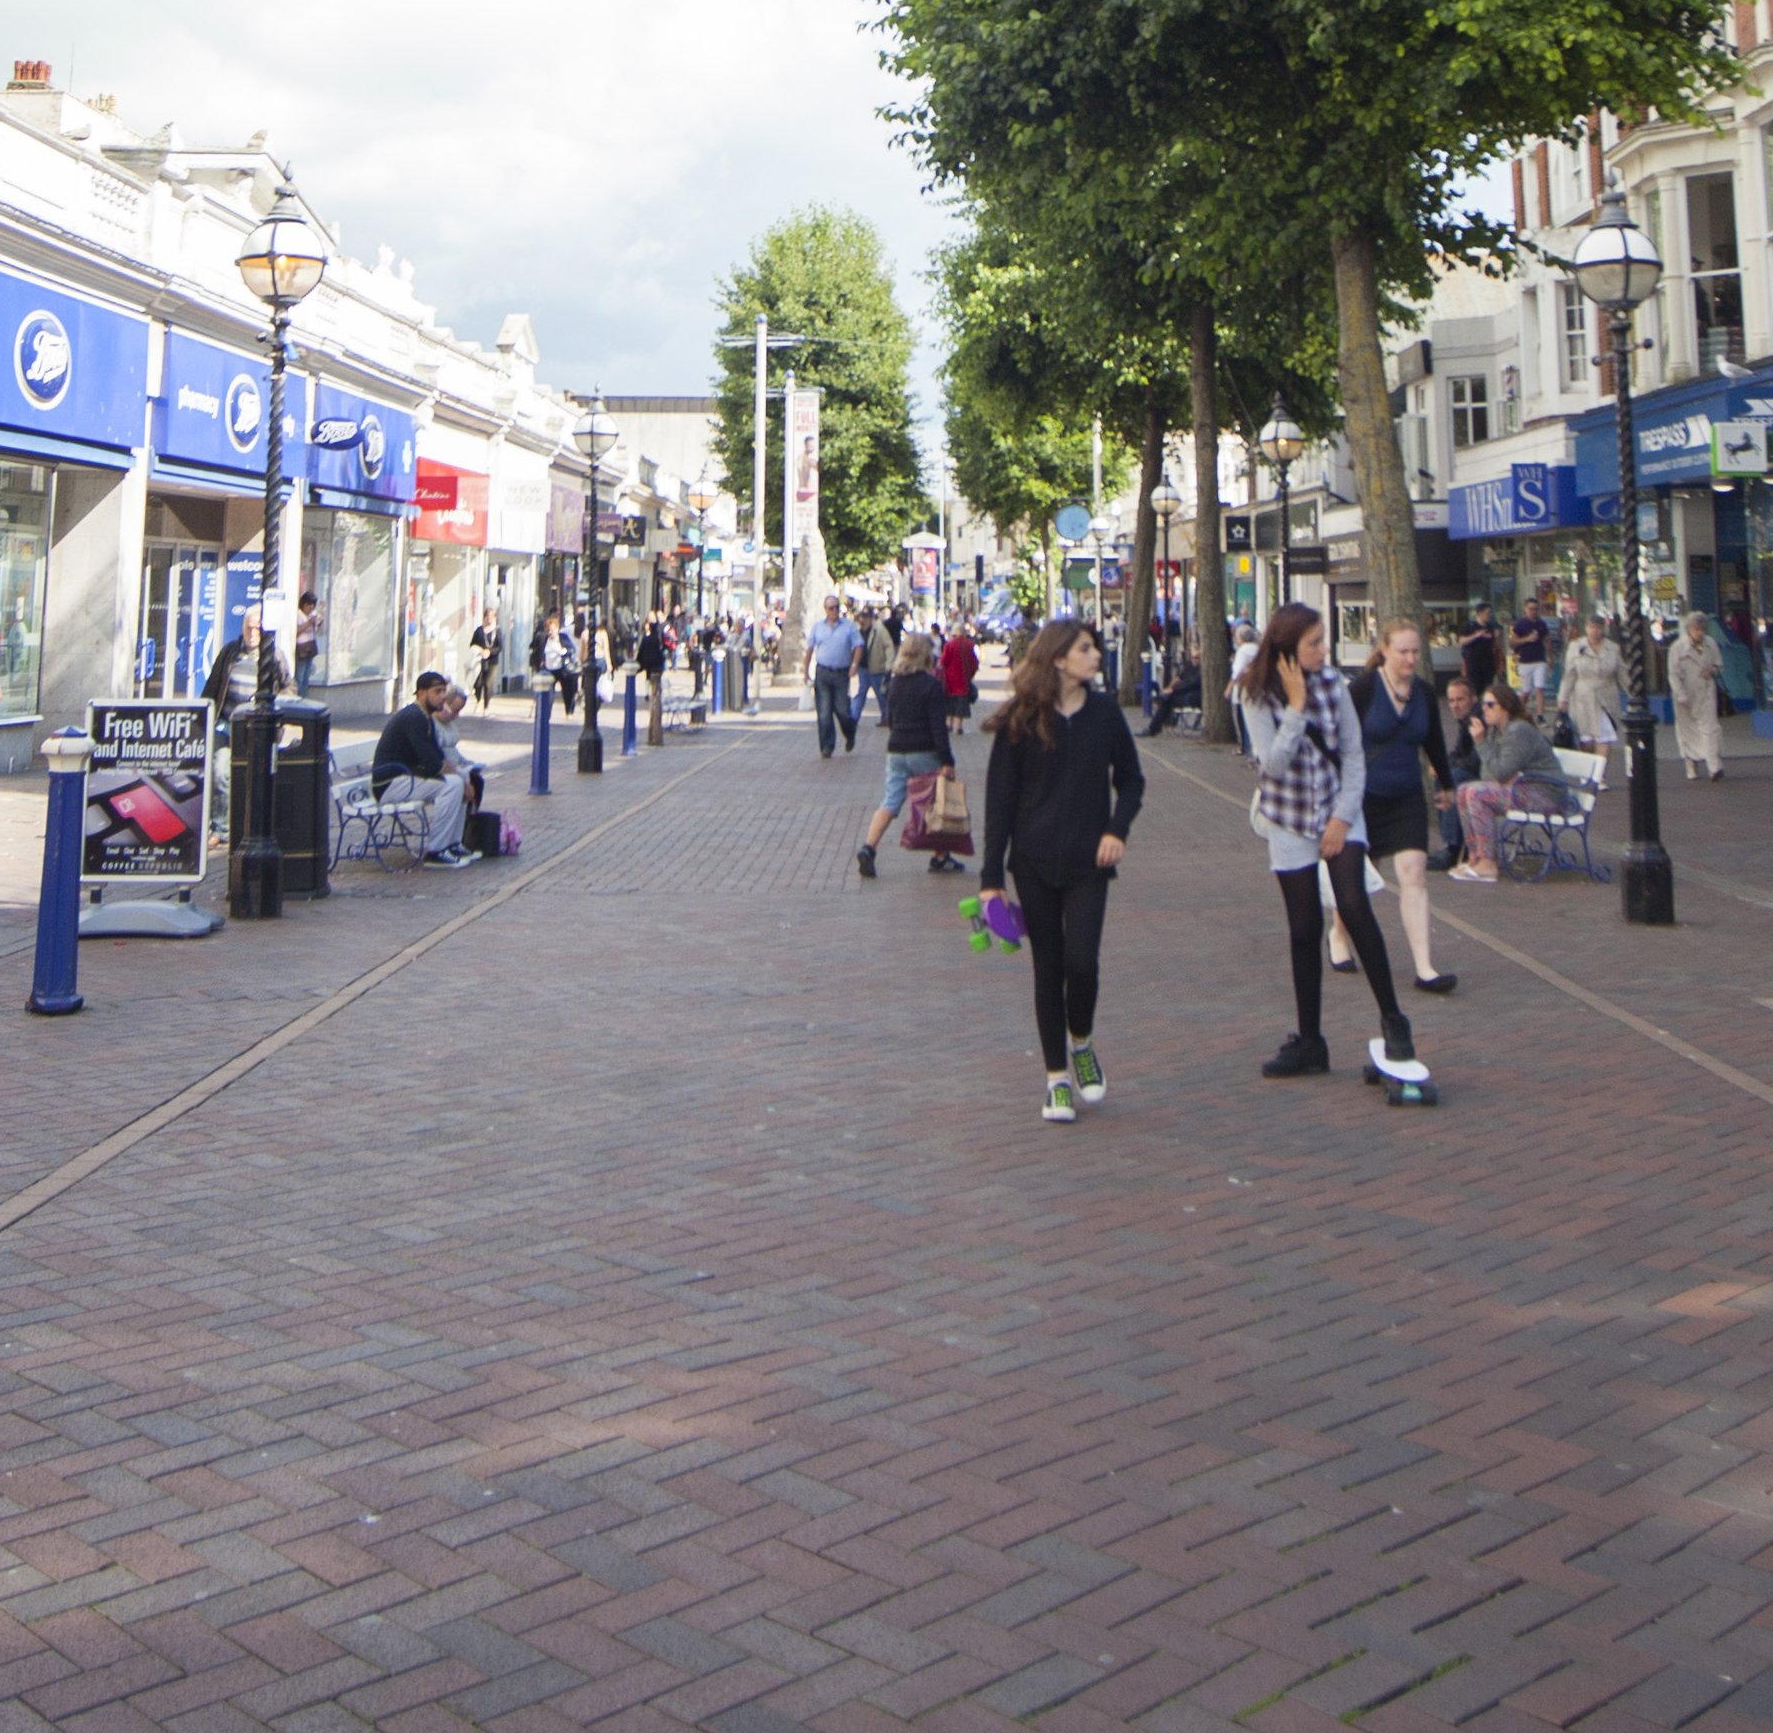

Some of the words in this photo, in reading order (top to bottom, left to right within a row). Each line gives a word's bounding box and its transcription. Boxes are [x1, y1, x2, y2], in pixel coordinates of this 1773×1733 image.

[103, 711, 145, 739] Free
[93, 739, 120, 759] and
[121, 739, 174, 759] Internet
[174, 738, 206, 759] Café
[101, 861, 135, 871] COFFEE
